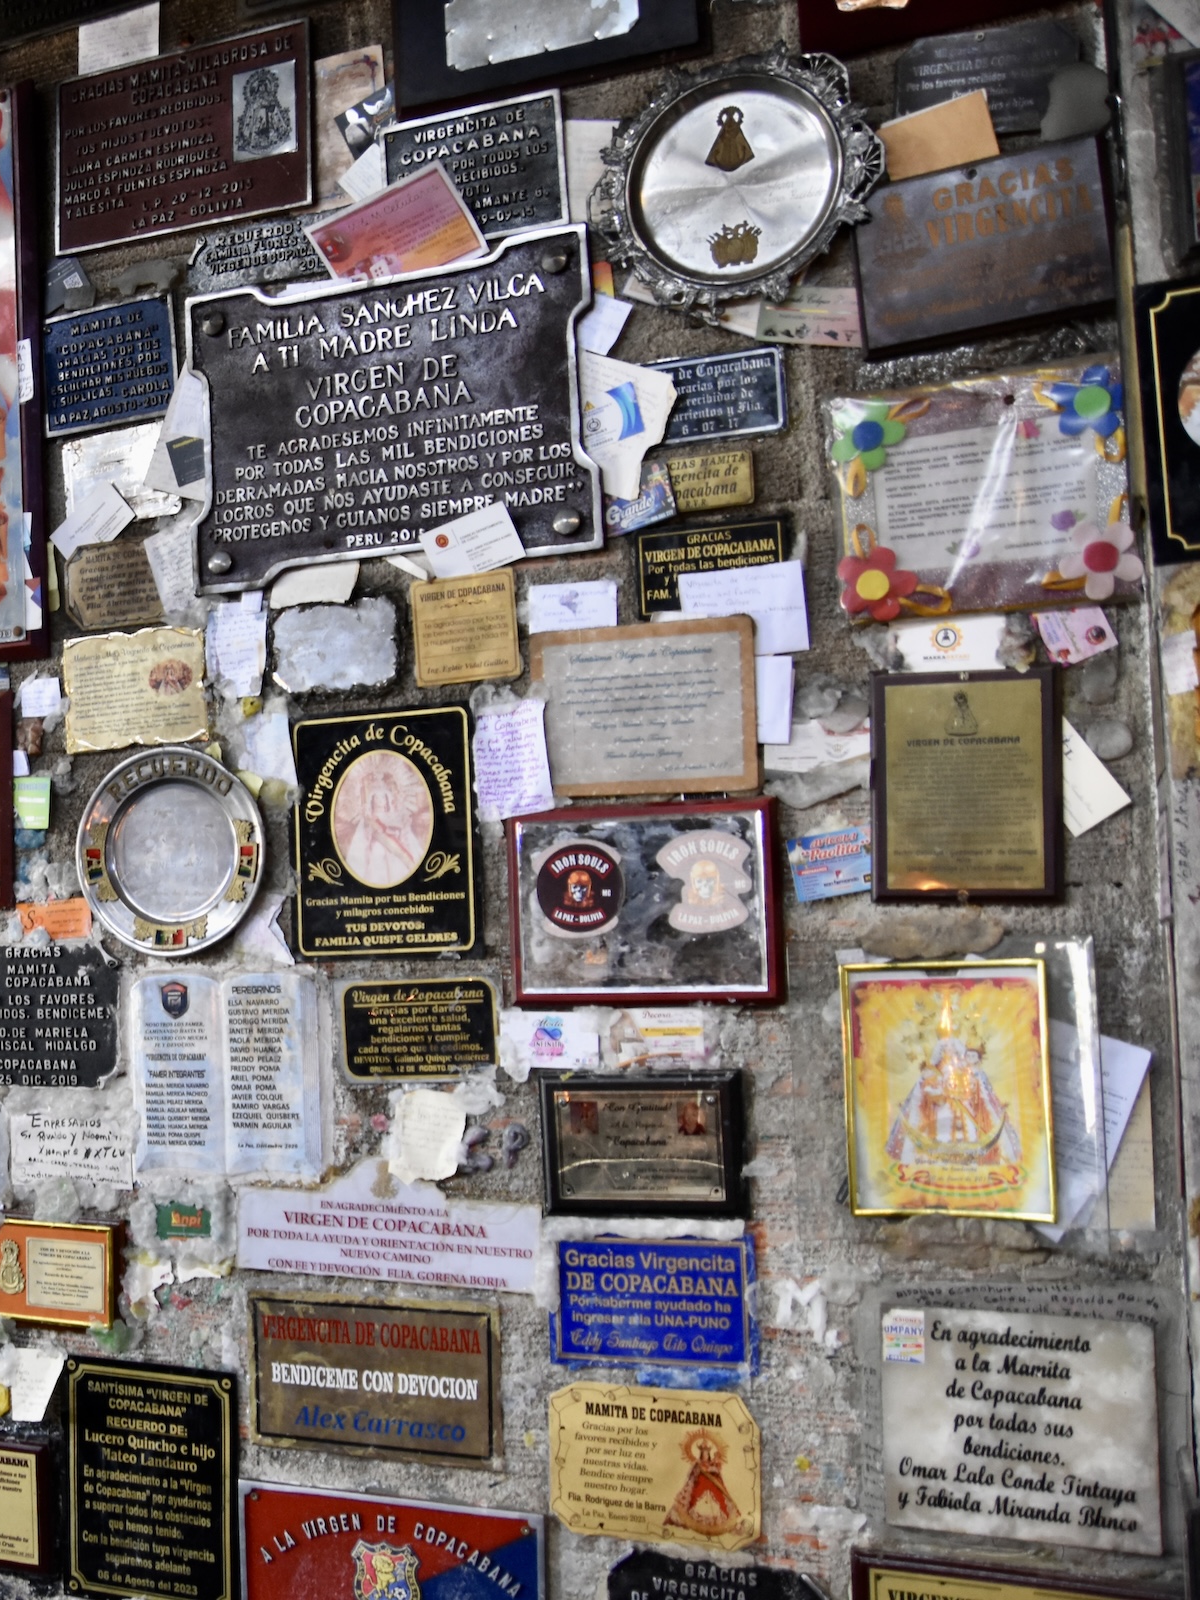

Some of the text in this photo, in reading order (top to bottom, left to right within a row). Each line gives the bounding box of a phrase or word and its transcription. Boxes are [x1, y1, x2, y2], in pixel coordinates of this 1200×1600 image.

[933, 158, 1074, 212] GRACIAS
[228, 272, 545, 350] FAMILIA SANCHEZ VILCA
[252, 310, 518, 375] A TI MADRE LINDA
[306, 355, 458, 400] VIRGEN DE
[295, 380, 473, 428] COPACABANA
[235, 424, 543, 482] POR TODAS LAS MIL BENDICIONES
[645, 538, 776, 562] VIRGEN DE COPACABANA
[687, 531, 732, 544] GRACIAS
[420, 583, 505, 602] VIRGEN DE COPACABANA
[907, 736, 1020, 748] VIRGEN DE COPACABANA
[109, 756, 235, 806] RECUERDO
[305, 723, 456, 823] Virgencita de Copacabana
[551, 853, 609, 874] IRON SOULS
[345, 921, 425, 933] TUS DEVOTOS:
[554, 910, 603, 923] LA PAZ BOLIVIA
[5, 947, 61, 958] GRACIAS
[315, 932, 458, 947] FAMILIA QUISPE GELDRES
[5, 976, 91, 988] COPACABANA
[7, 964, 56, 974] MAMITA
[22, 1075, 47, 1085] DIC.
[52, 1075, 78, 1085] 2019
[284, 1211, 487, 1238] VIRGEN DE COPACABANA
[565, 1249, 735, 1272] Gracias Virgencita
[567, 1272, 738, 1297] DE COPACABANA
[262, 1315, 481, 1354] VIRGENCITA DE COPACABANA
[931, 1320, 1091, 1352] En agradecimiento
[955, 1353, 1072, 1380] a la Mamita
[271, 1362, 478, 1400] BENDICEME CON DEVOCION
[946, 1379, 1083, 1410] de Copacabana
[294, 1405, 466, 1442] Alex Carrasco
[585, 1401, 722, 1427] MAMITA DE COPACABANA
[954, 1413, 1073, 1438] por todas sus
[85, 1429, 215, 1459] Lucero Quincho e hijo
[963, 1437, 1065, 1466] bendiciones.
[102, 1448, 197, 1473] Mateo Landauro
[260, 1513, 522, 1598] A LA VIRGEN DE COPACABANA
